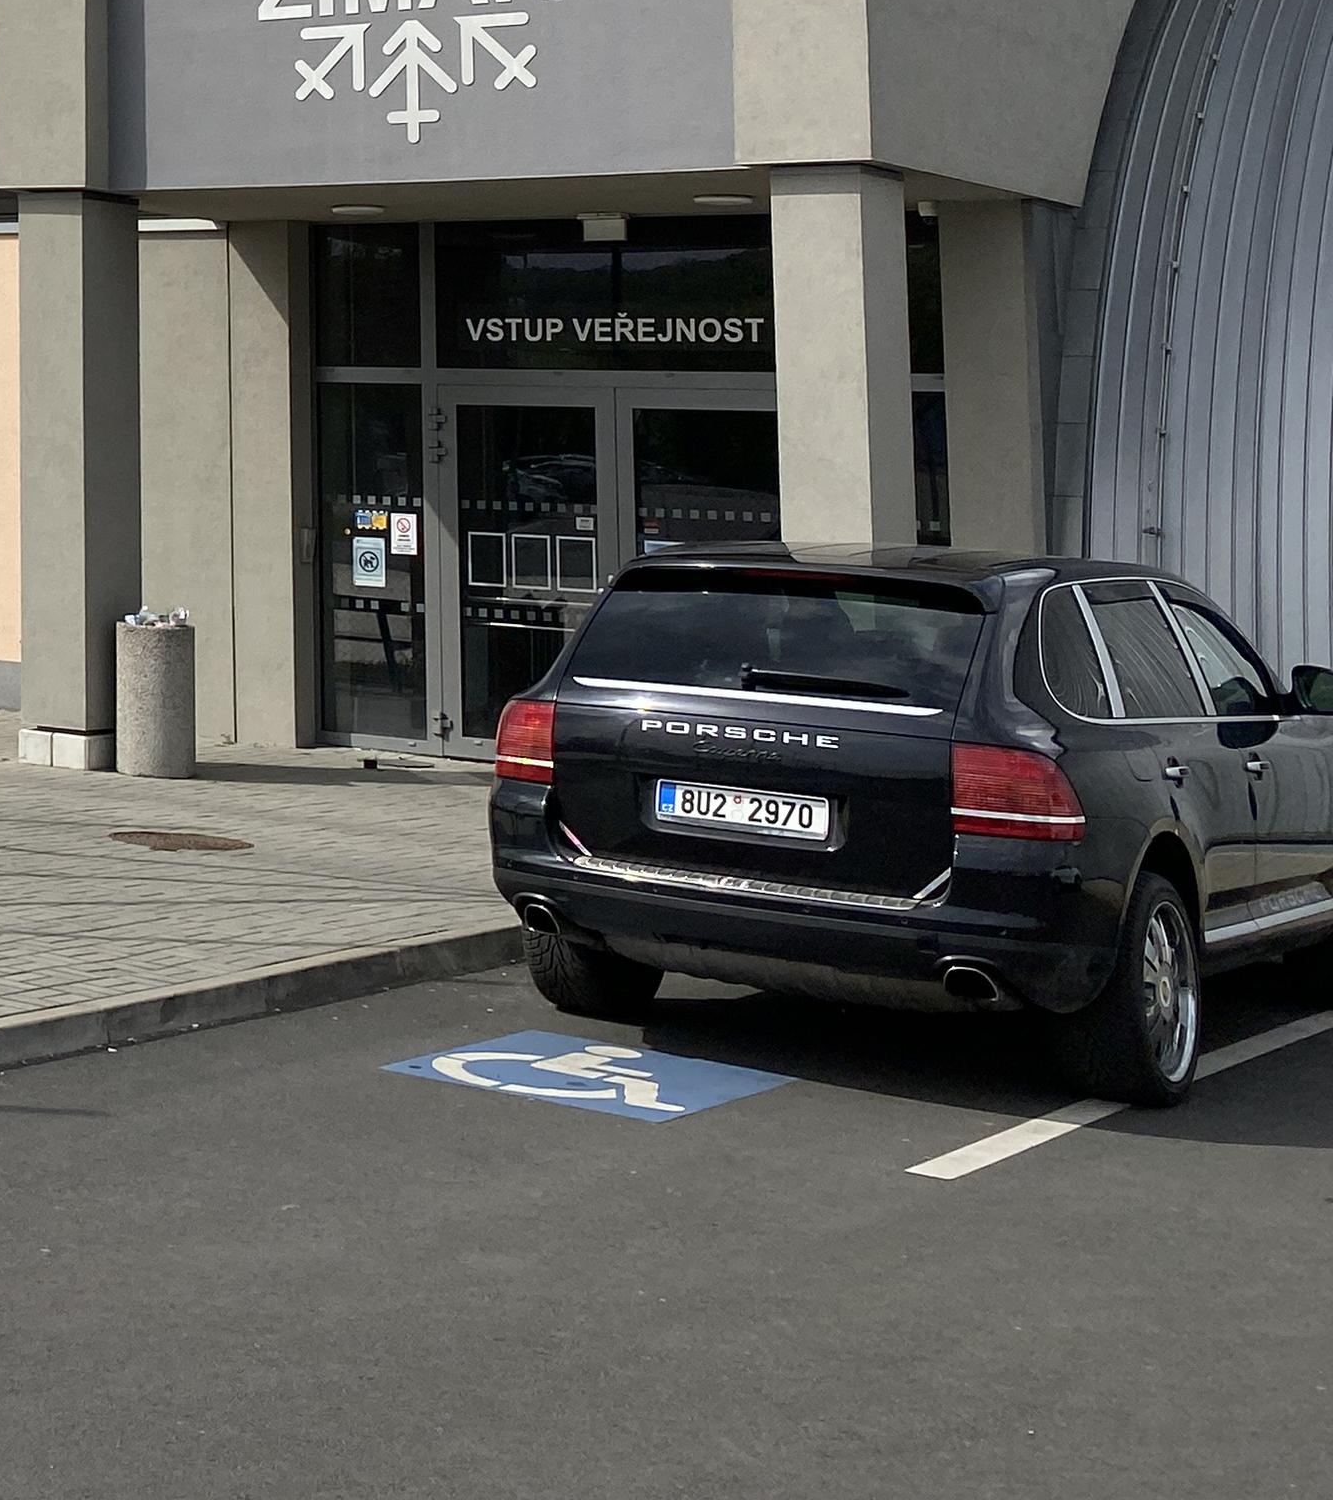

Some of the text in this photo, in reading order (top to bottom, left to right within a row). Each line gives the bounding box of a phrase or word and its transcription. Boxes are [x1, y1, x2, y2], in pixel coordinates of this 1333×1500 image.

[465, 312, 765, 343] VSTUP VEŘEJNOST
[640, 719, 840, 749] PORSCHE
[682, 789, 727, 819] 8U2
[747, 796, 814, 829] 2970
